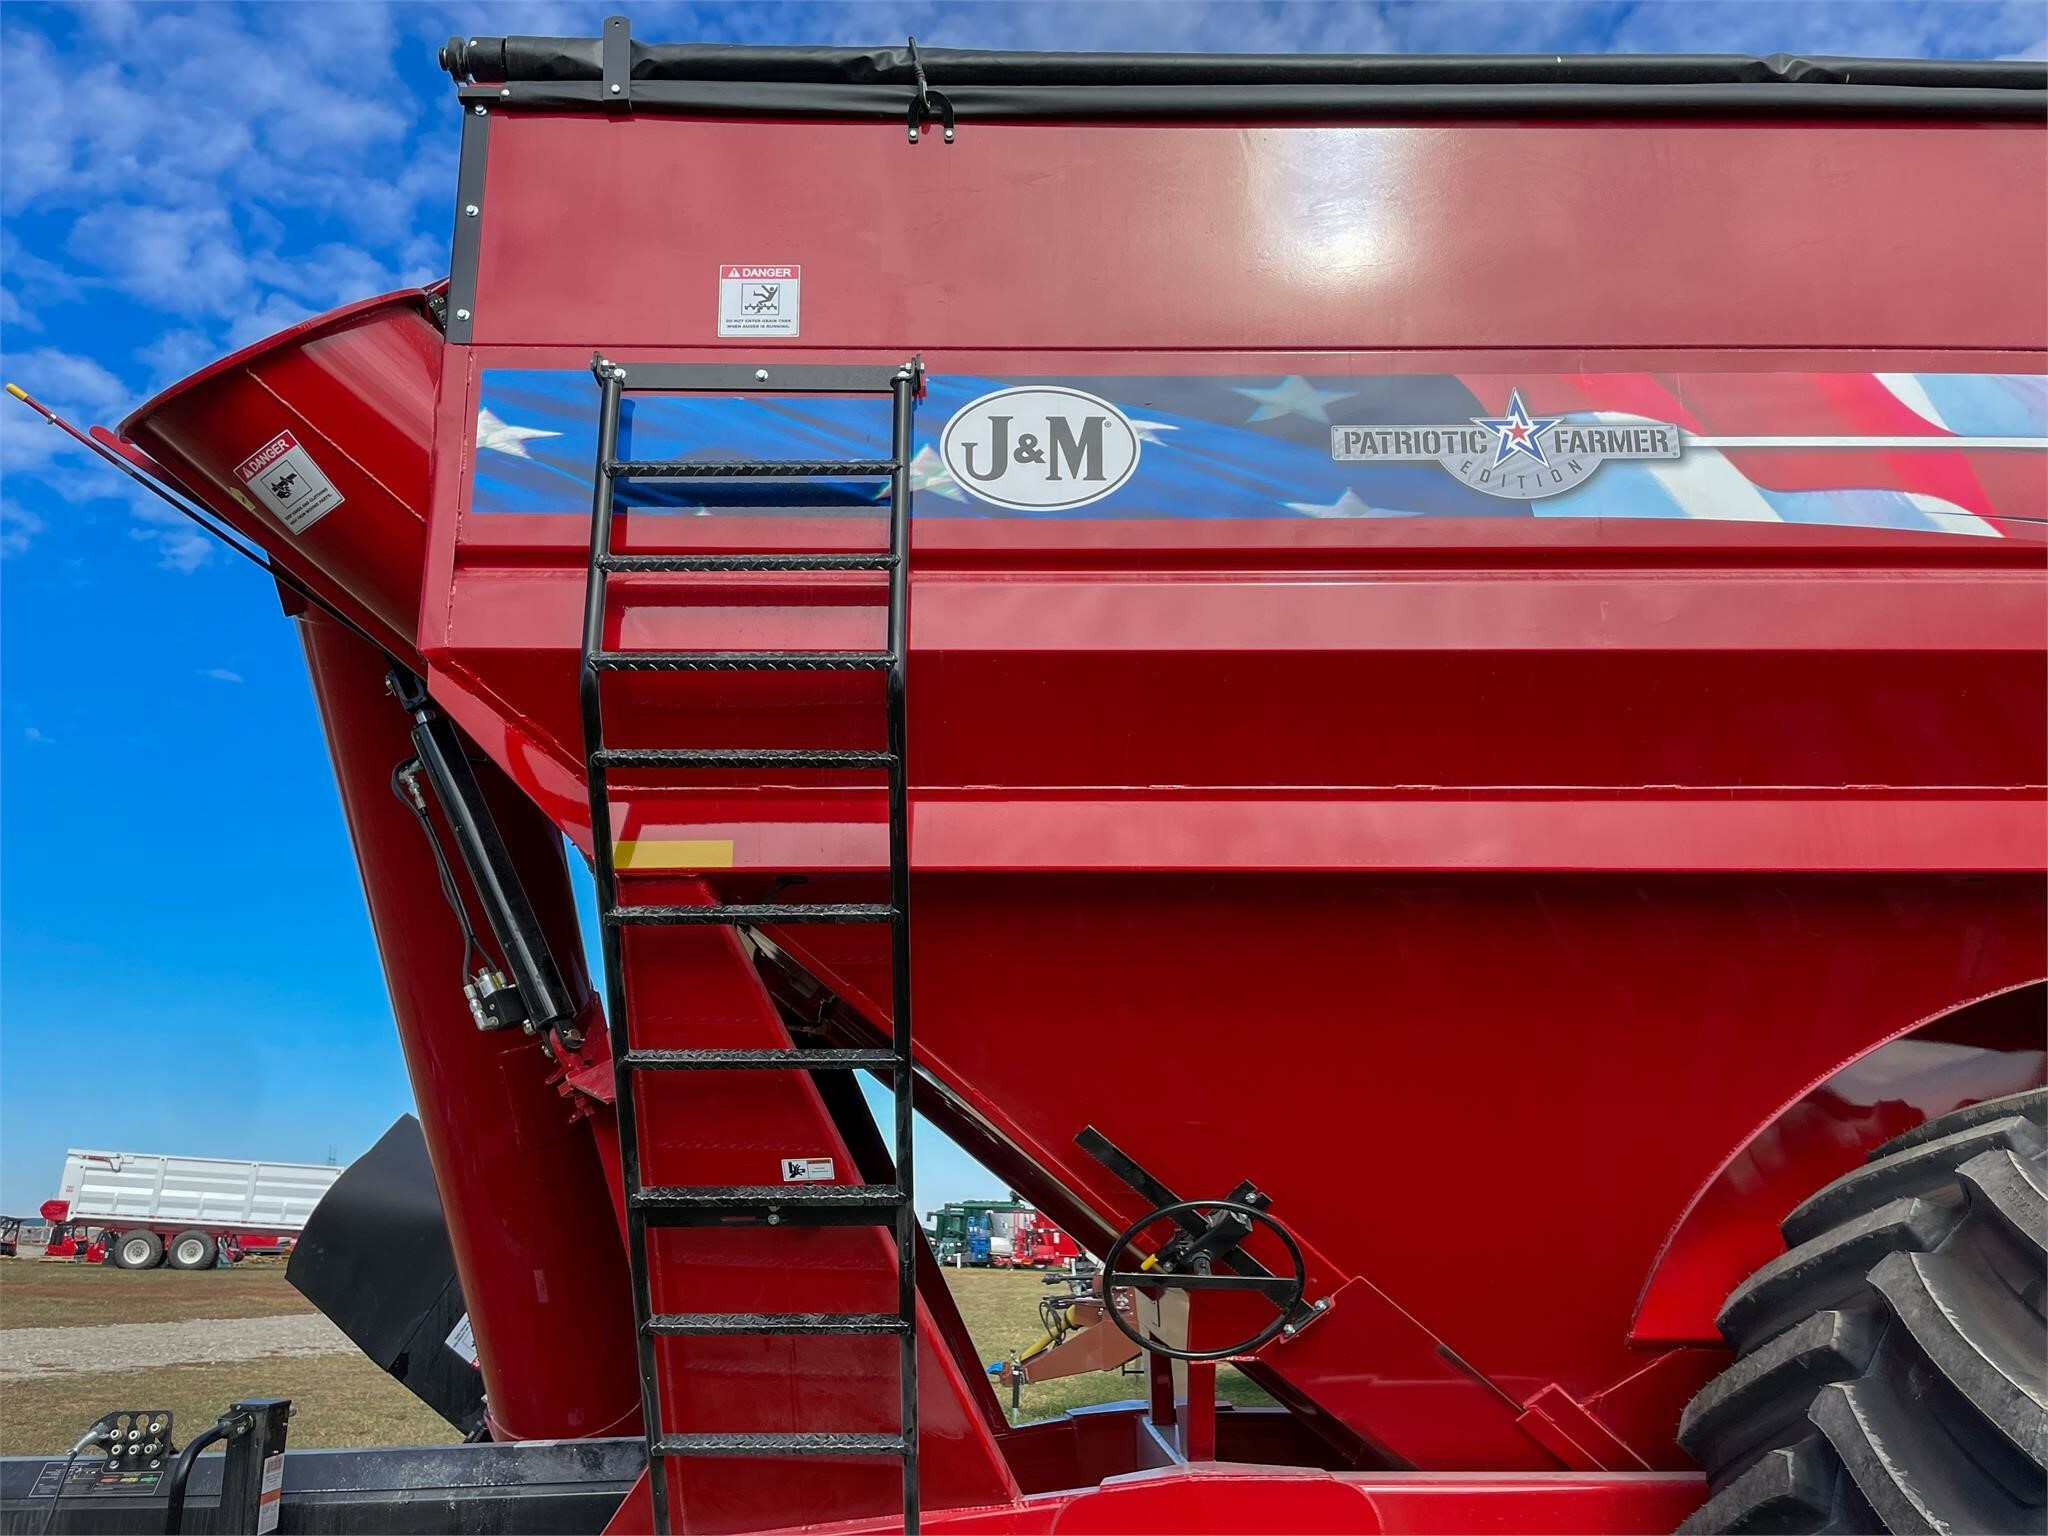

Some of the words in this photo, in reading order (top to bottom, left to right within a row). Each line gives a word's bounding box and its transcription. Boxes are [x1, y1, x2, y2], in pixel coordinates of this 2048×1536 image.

[742, 268, 792, 277] DANGER
[248, 438, 290, 472] DANGER
[961, 415, 1108, 482] J&M
[1344, 429, 1488, 455] PATRIOTIC
[1554, 429, 1670, 454] FARMER
[1459, 458, 1584, 490] EDITION
